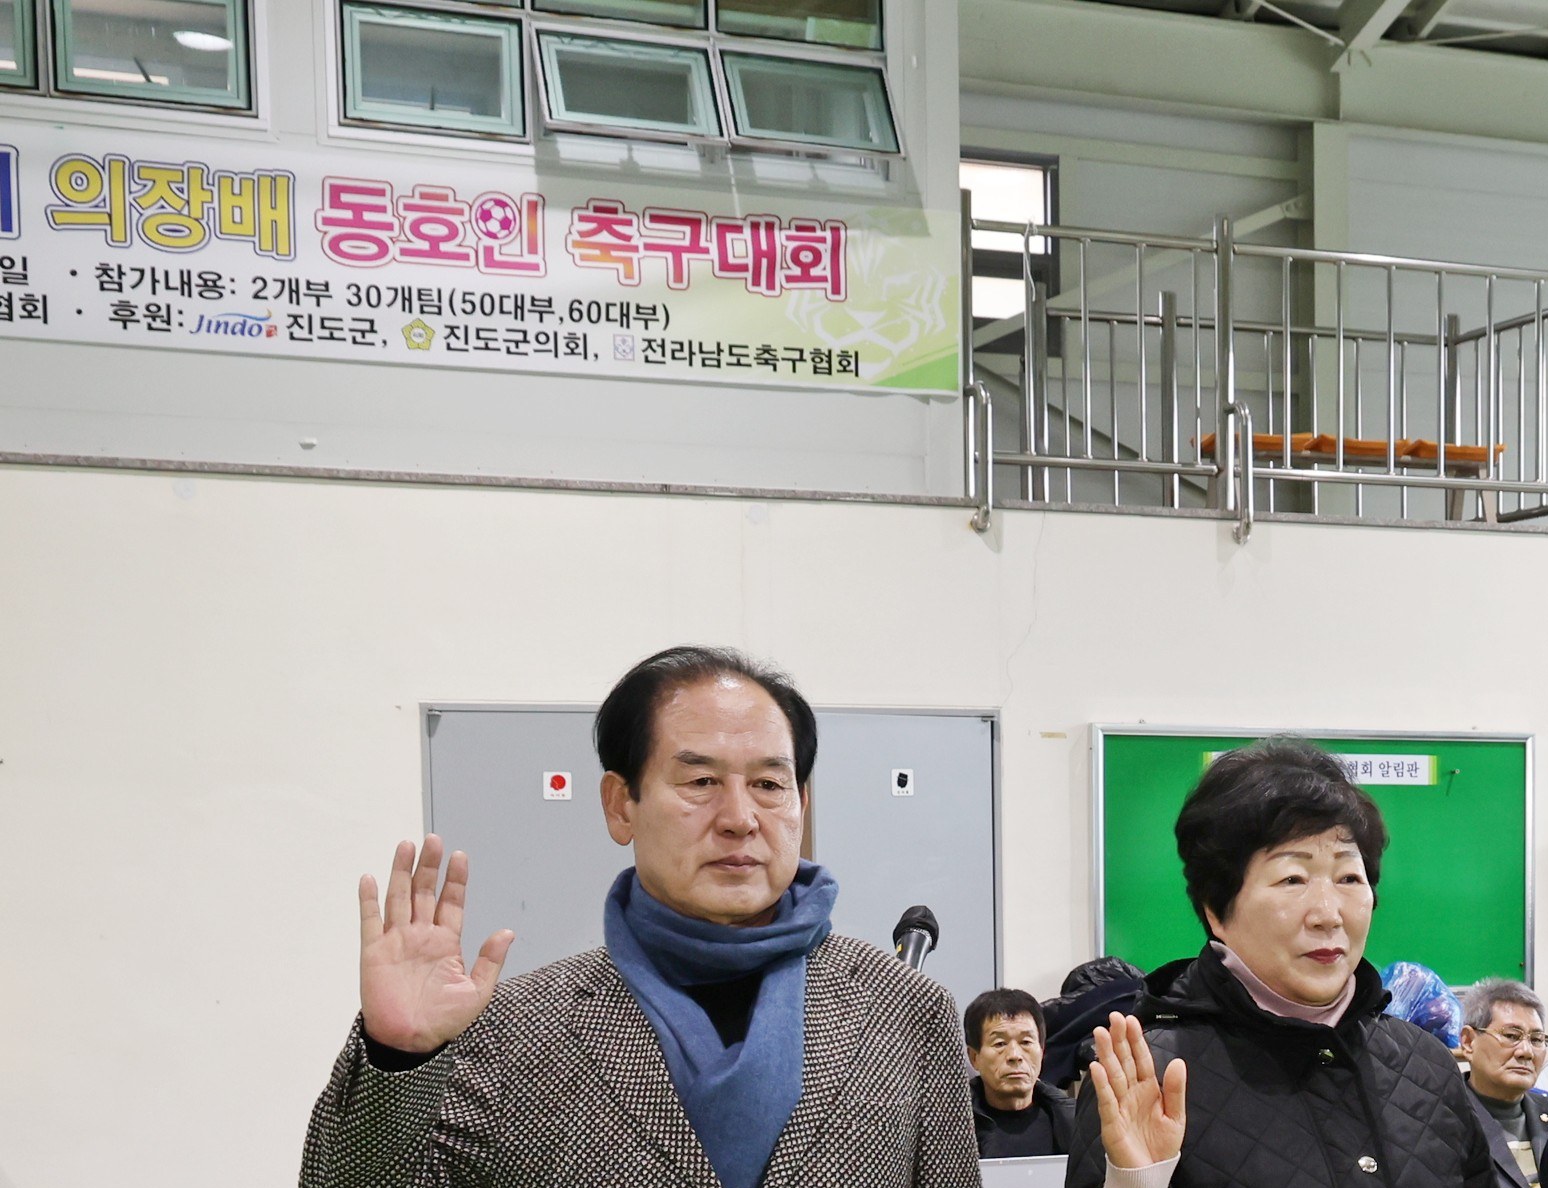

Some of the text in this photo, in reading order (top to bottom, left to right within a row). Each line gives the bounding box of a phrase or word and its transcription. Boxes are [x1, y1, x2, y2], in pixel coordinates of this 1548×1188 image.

[47, 154, 294, 259] 의장배
[316, 178, 546, 275] 동호인
[567, 200, 845, 300] 축구대회
[94, 262, 670, 331] 참가내용: 2개부 30개팀(50대부,60대부)
[108, 300, 184, 333] 후원:
[285, 313, 387, 348] 진도군,
[443, 324, 599, 361] 진도군의회,
[641, 337, 860, 378] 전라남도축구협회
[1379, 760, 1421, 778] 알림판
